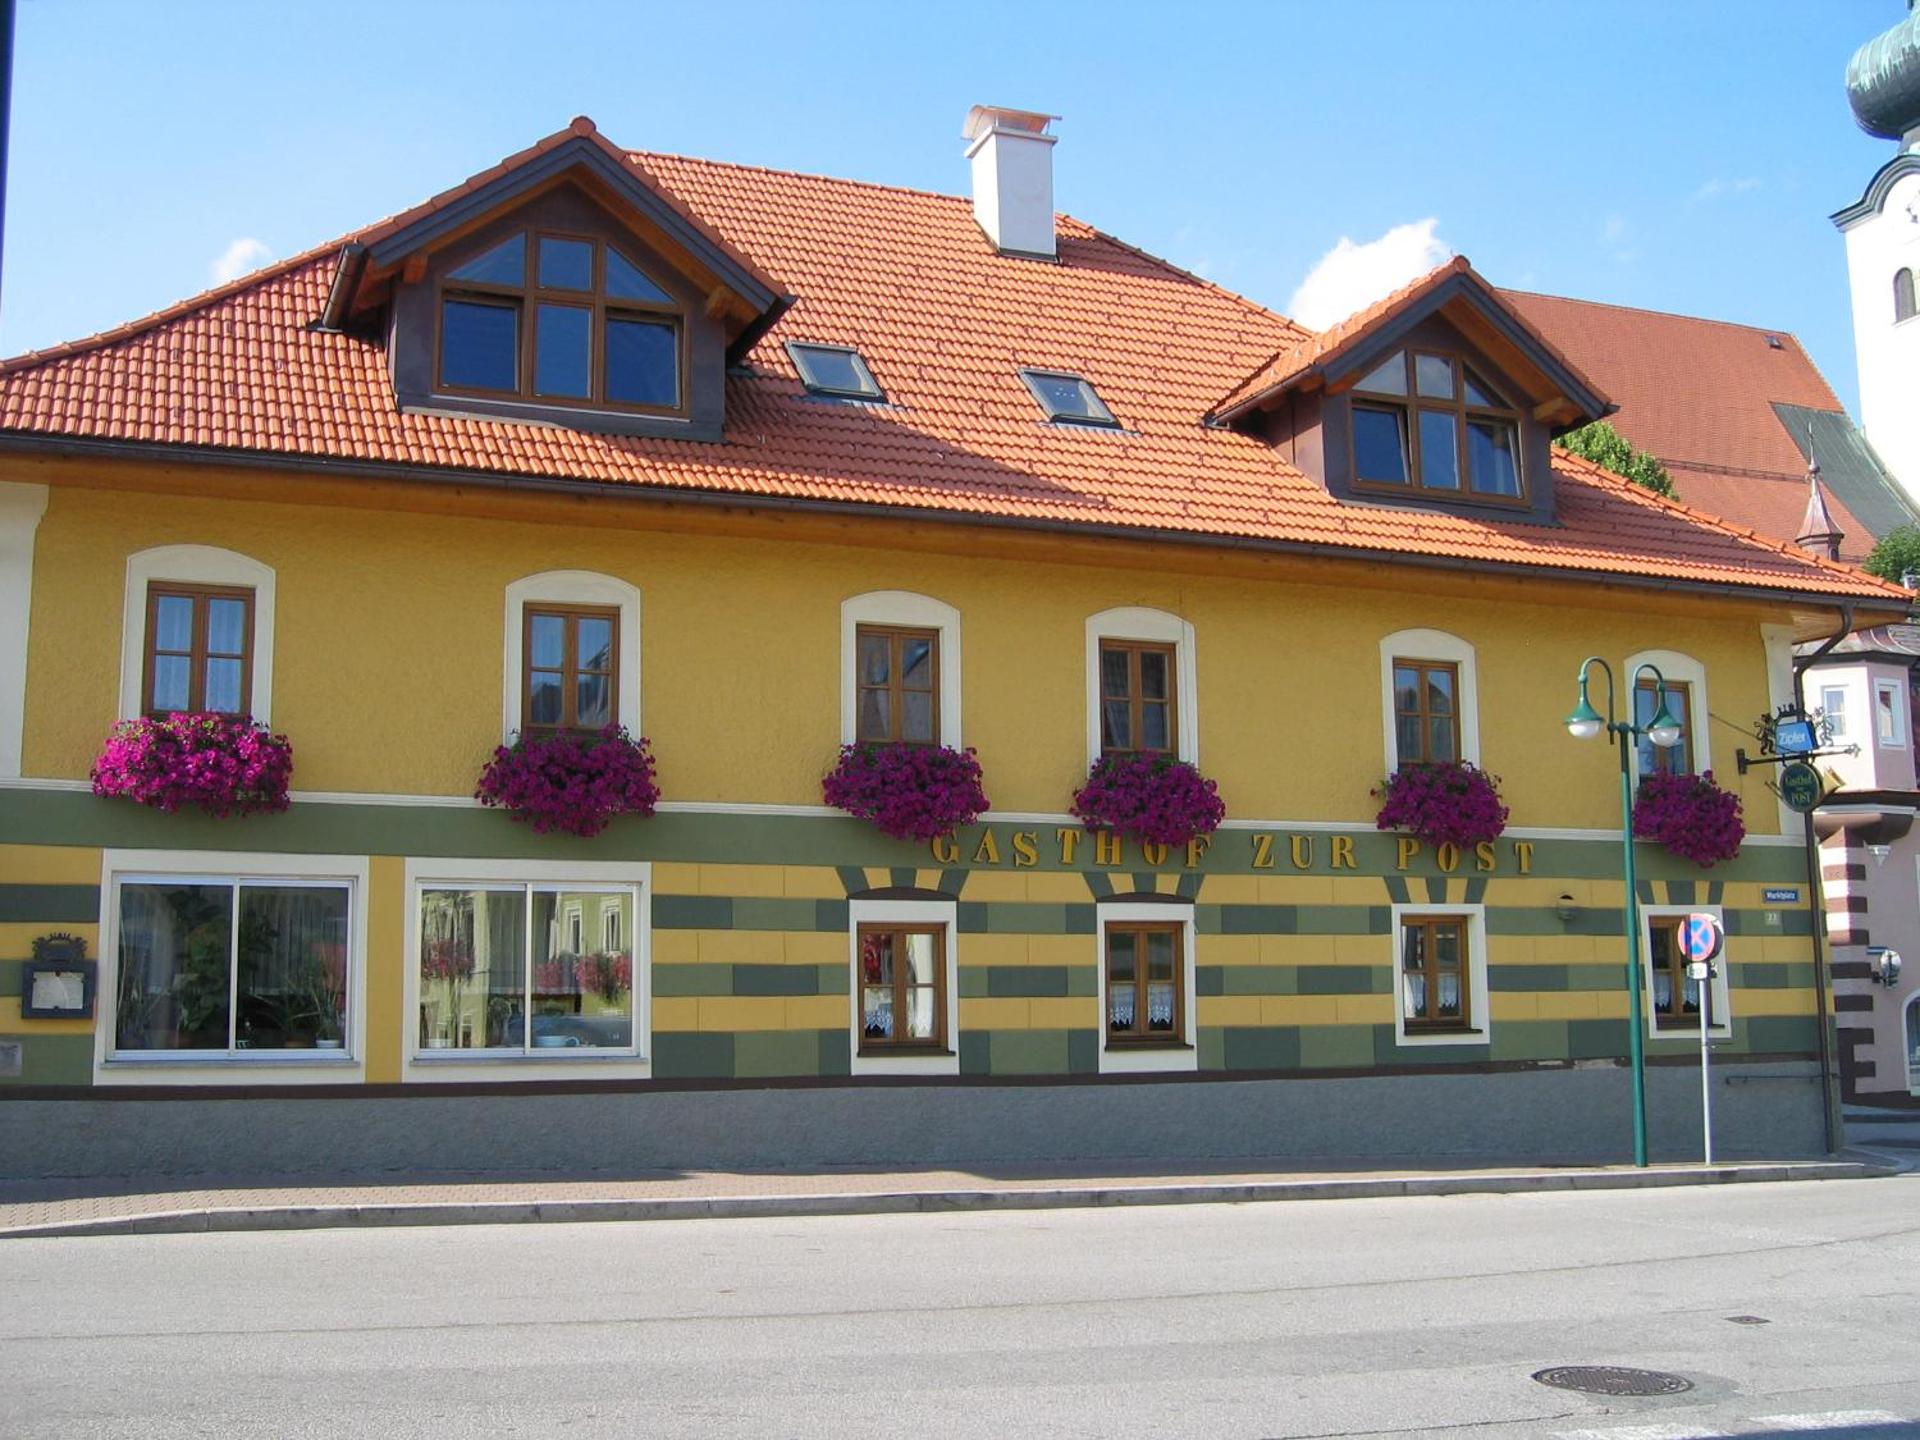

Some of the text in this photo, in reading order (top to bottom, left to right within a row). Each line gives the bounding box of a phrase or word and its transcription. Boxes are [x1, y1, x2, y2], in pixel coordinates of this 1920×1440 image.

[931, 827, 1534, 874] GASTHOF ZUR POST
